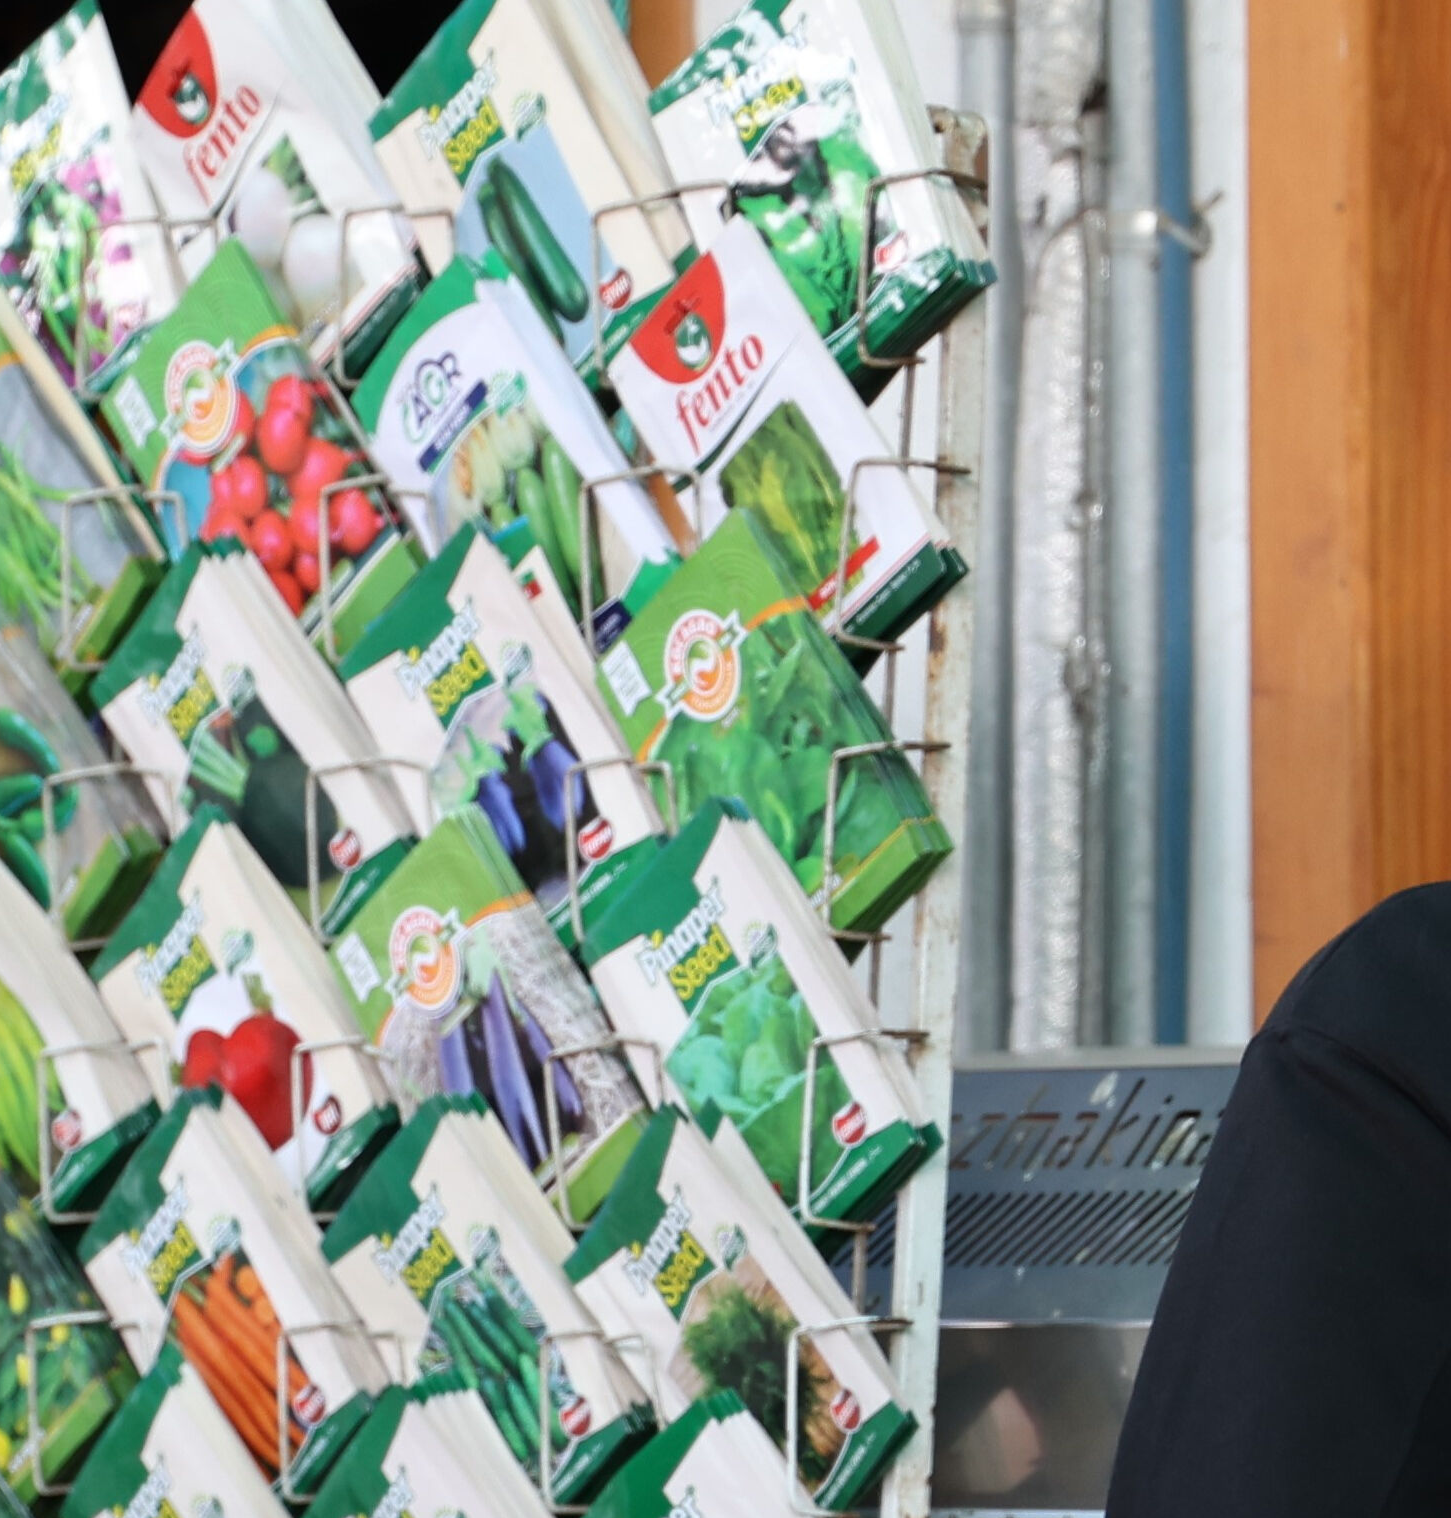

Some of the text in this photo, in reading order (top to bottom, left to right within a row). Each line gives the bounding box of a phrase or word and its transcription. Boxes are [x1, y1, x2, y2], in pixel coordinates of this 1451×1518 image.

[183, 84, 260, 205] fento
[418, 62, 496, 159] Pinaper
[443, 97, 499, 175] Seed
[676, 332, 763, 455] fento
[400, 604, 481, 700] Pinaper
[426, 643, 487, 714] Seed
[640, 886, 727, 985] Pinaper
[669, 925, 735, 1000] Seed
[625, 1194, 694, 1293] Pinaper
[655, 1231, 705, 1308] Seed
